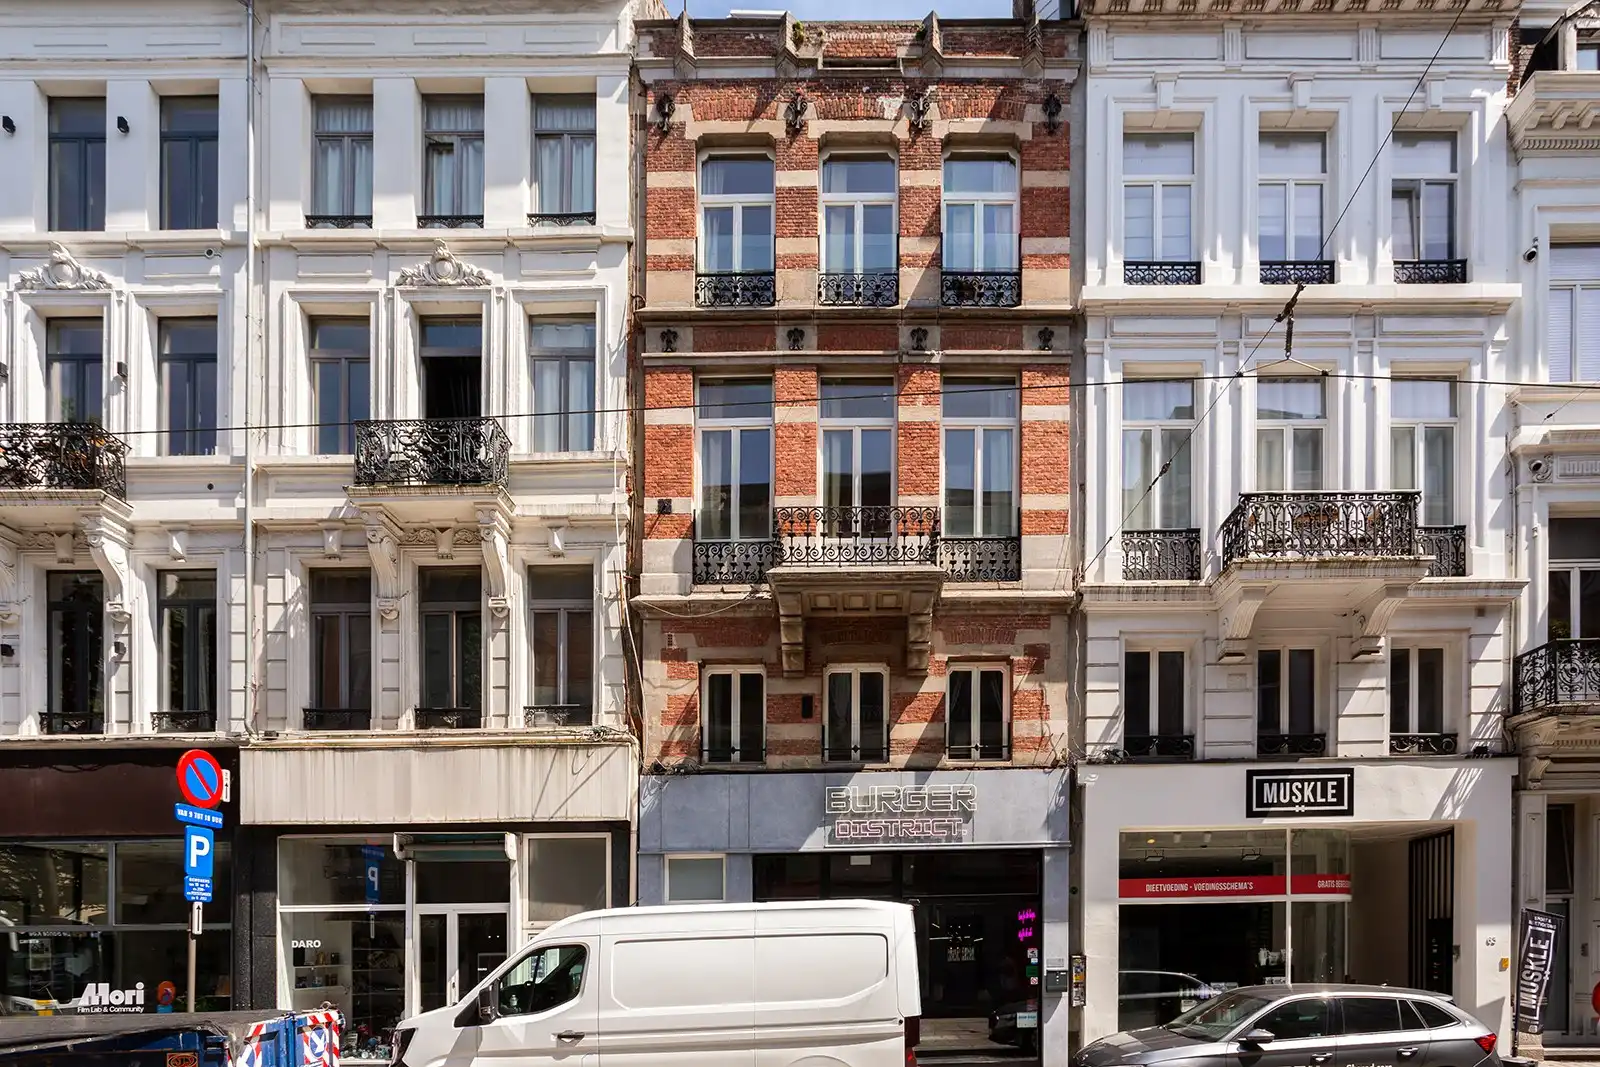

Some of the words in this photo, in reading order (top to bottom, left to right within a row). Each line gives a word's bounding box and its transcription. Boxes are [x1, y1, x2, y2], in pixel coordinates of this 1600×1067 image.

[825, 784, 977, 814] BURGER
[1263, 781, 1337, 803] MUSKLE
[190, 834, 210, 868] P
[1146, 883, 1188, 892] DIEETVOEDING
[1193, 881, 1254, 891] VOEDINGSSCHEMA'S
[291, 940, 321, 948] DARO
[1520, 937, 1549, 1010] MUSKLE
[78, 981, 144, 1005] Mori
